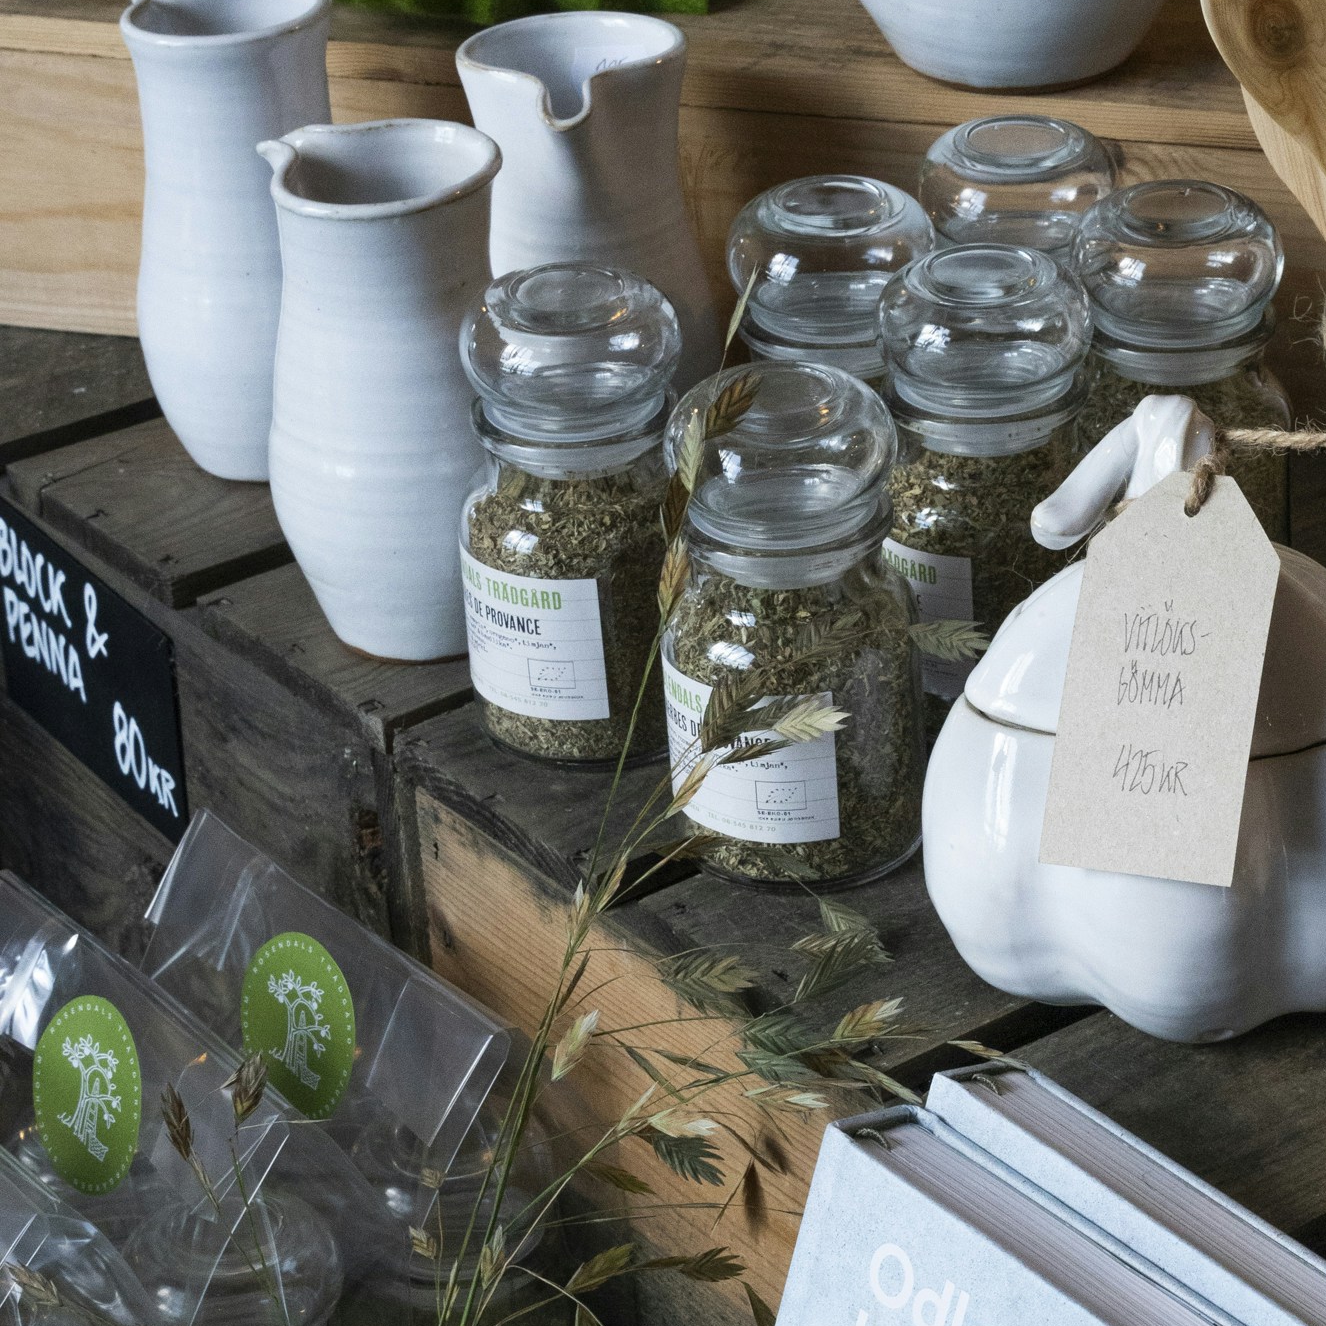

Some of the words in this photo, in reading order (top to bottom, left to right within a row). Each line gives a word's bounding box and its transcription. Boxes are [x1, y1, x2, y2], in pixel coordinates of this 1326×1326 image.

[0, 516, 72, 629] BLOCK
[83, 582, 110, 659] &
[485, 577, 562, 611] TRÄDGÅRD
[475, 601, 484, 617] DE
[486, 605, 542, 636] PROVANCE
[3, 586, 87, 704] PENNA
[1117, 659, 1184, 710] GÖMMA
[253, 940, 313, 974] ROSENDALS
[49, 1002, 113, 1034] ROSENDALS
